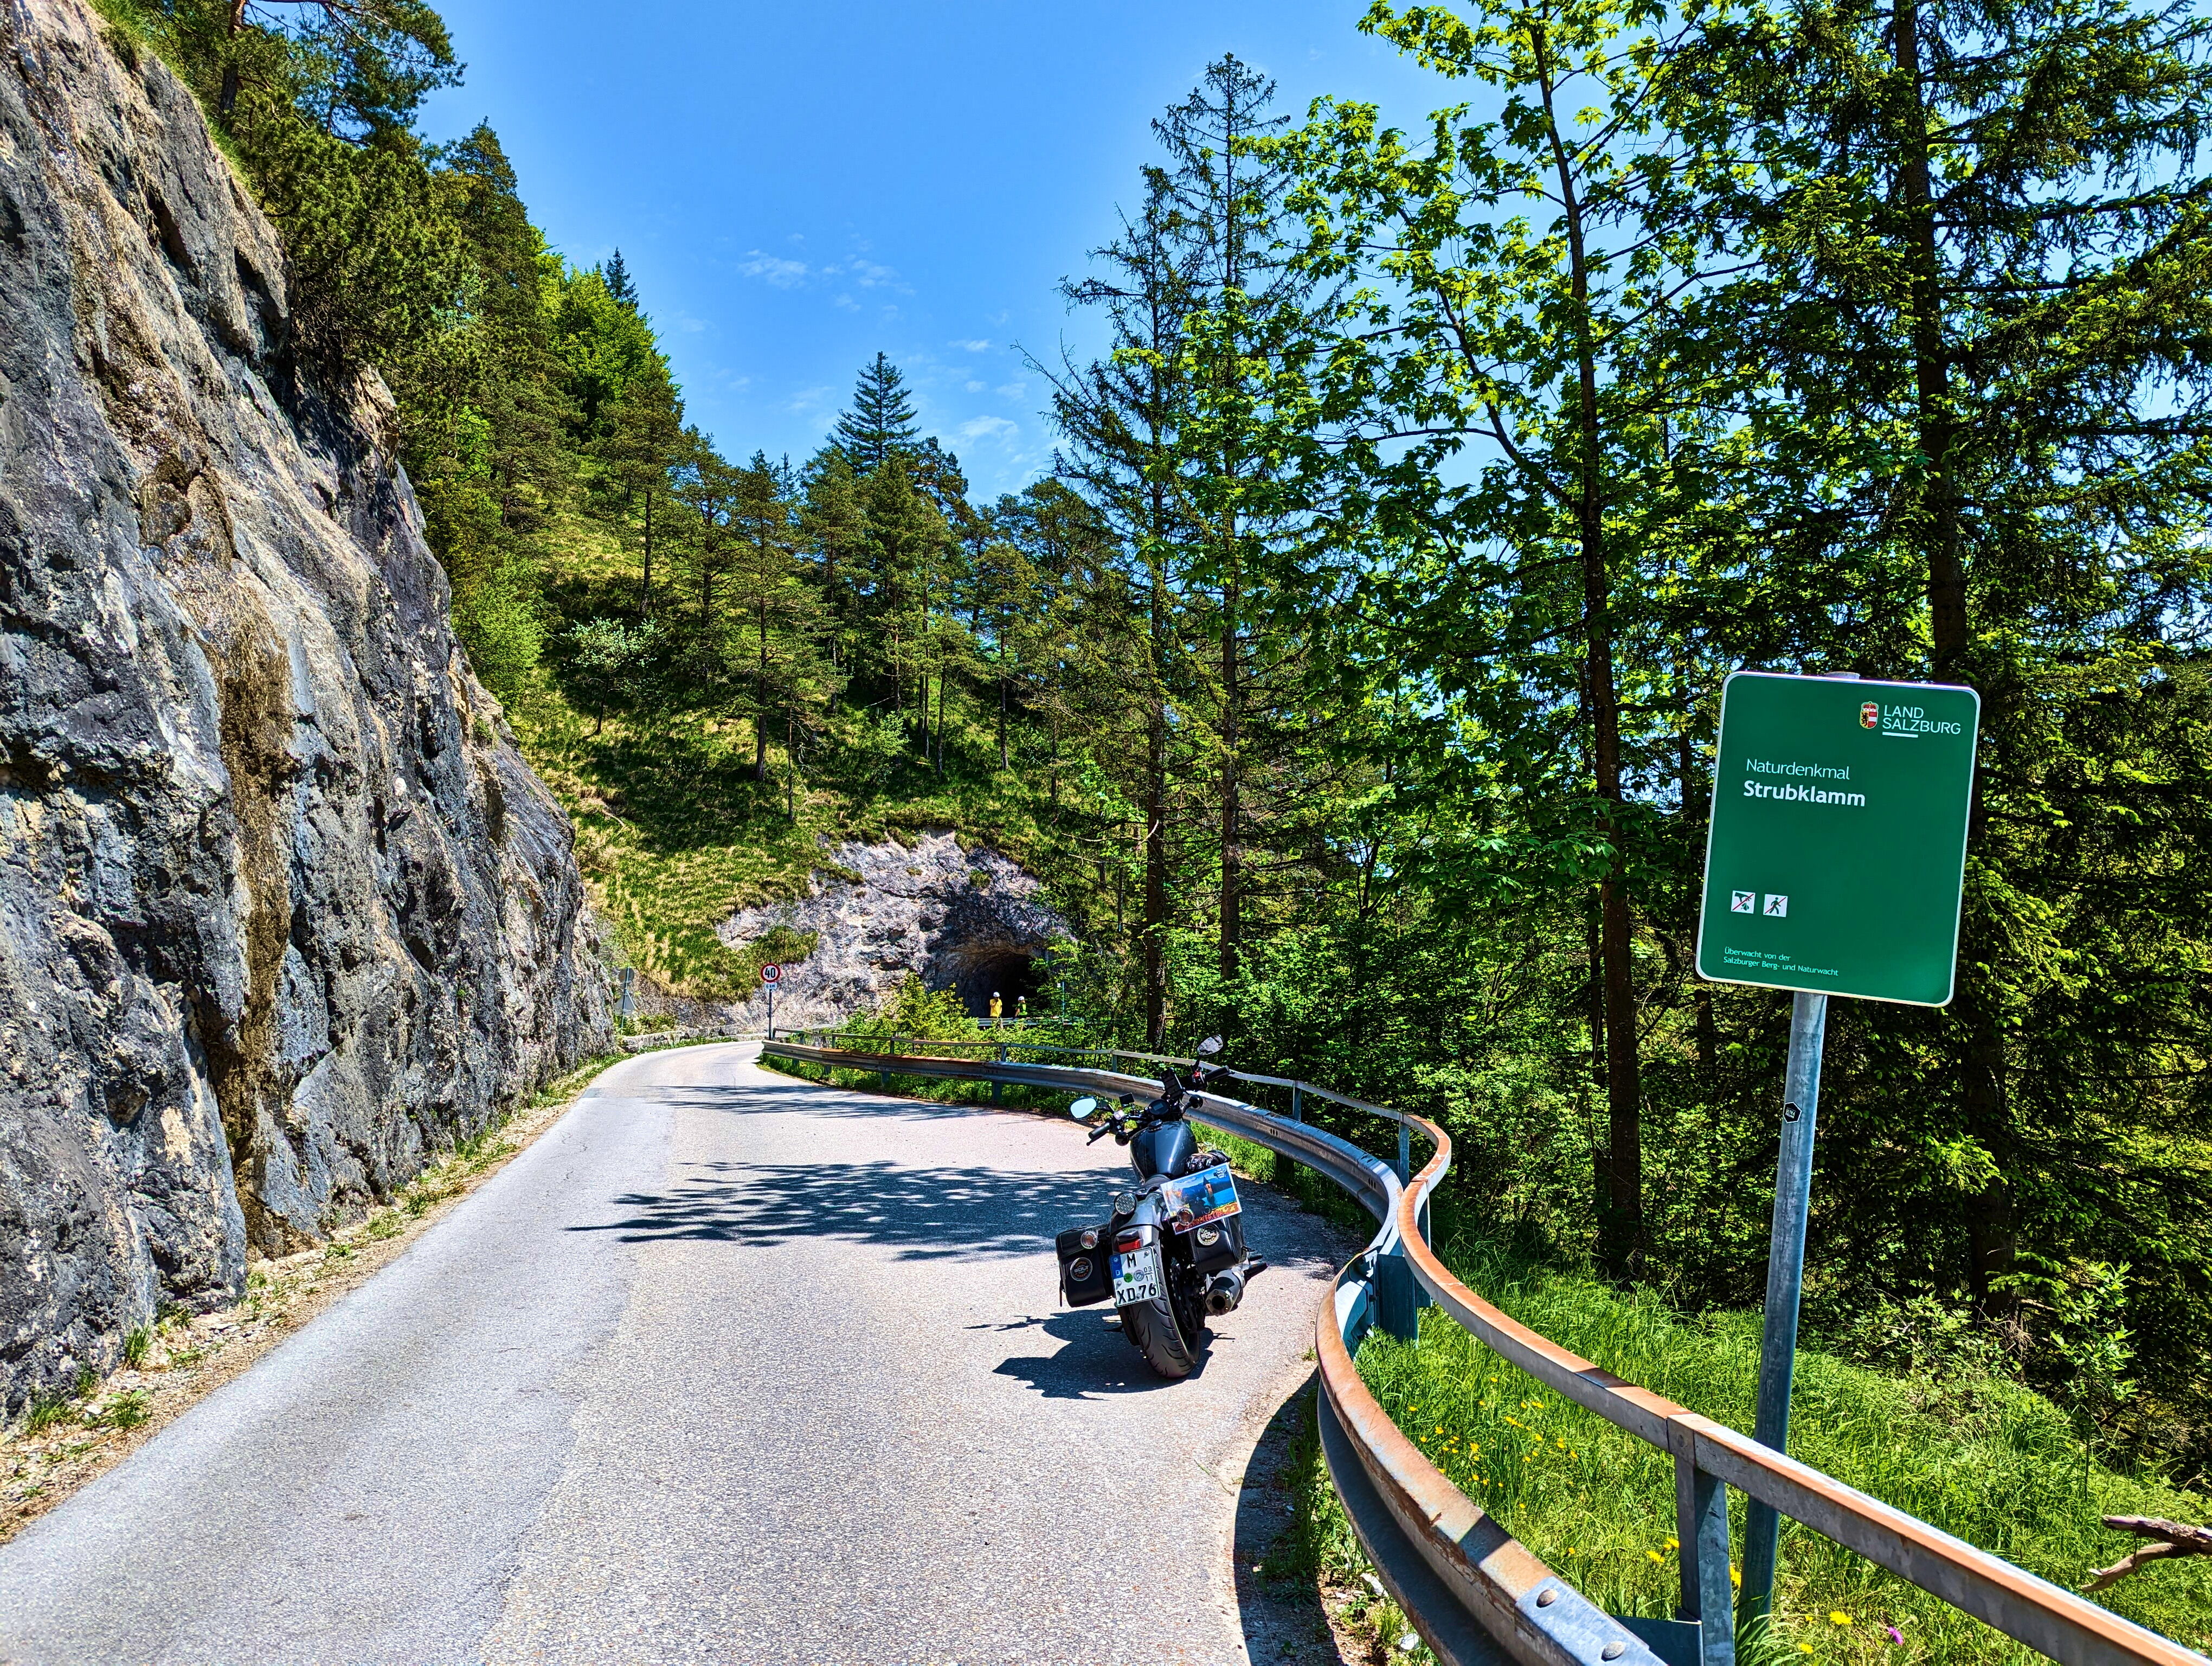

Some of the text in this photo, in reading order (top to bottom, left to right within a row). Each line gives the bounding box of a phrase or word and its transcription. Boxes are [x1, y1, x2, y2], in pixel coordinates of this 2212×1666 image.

[1884, 704, 1924, 719] LAND
[1882, 717, 1961, 735] SALZBURG
[1746, 758, 1850, 780] Naturdenkmal
[1744, 780, 1866, 807] Strubklamm
[1725, 946, 1761, 958] Überwacht
[765, 967, 775, 978] 40
[1724, 956, 1760, 967] Salzburger
[1761, 961, 1780, 970] Berg-
[1798, 965, 1839, 976] Naturwacht
[1127, 1253, 1137, 1268] M
